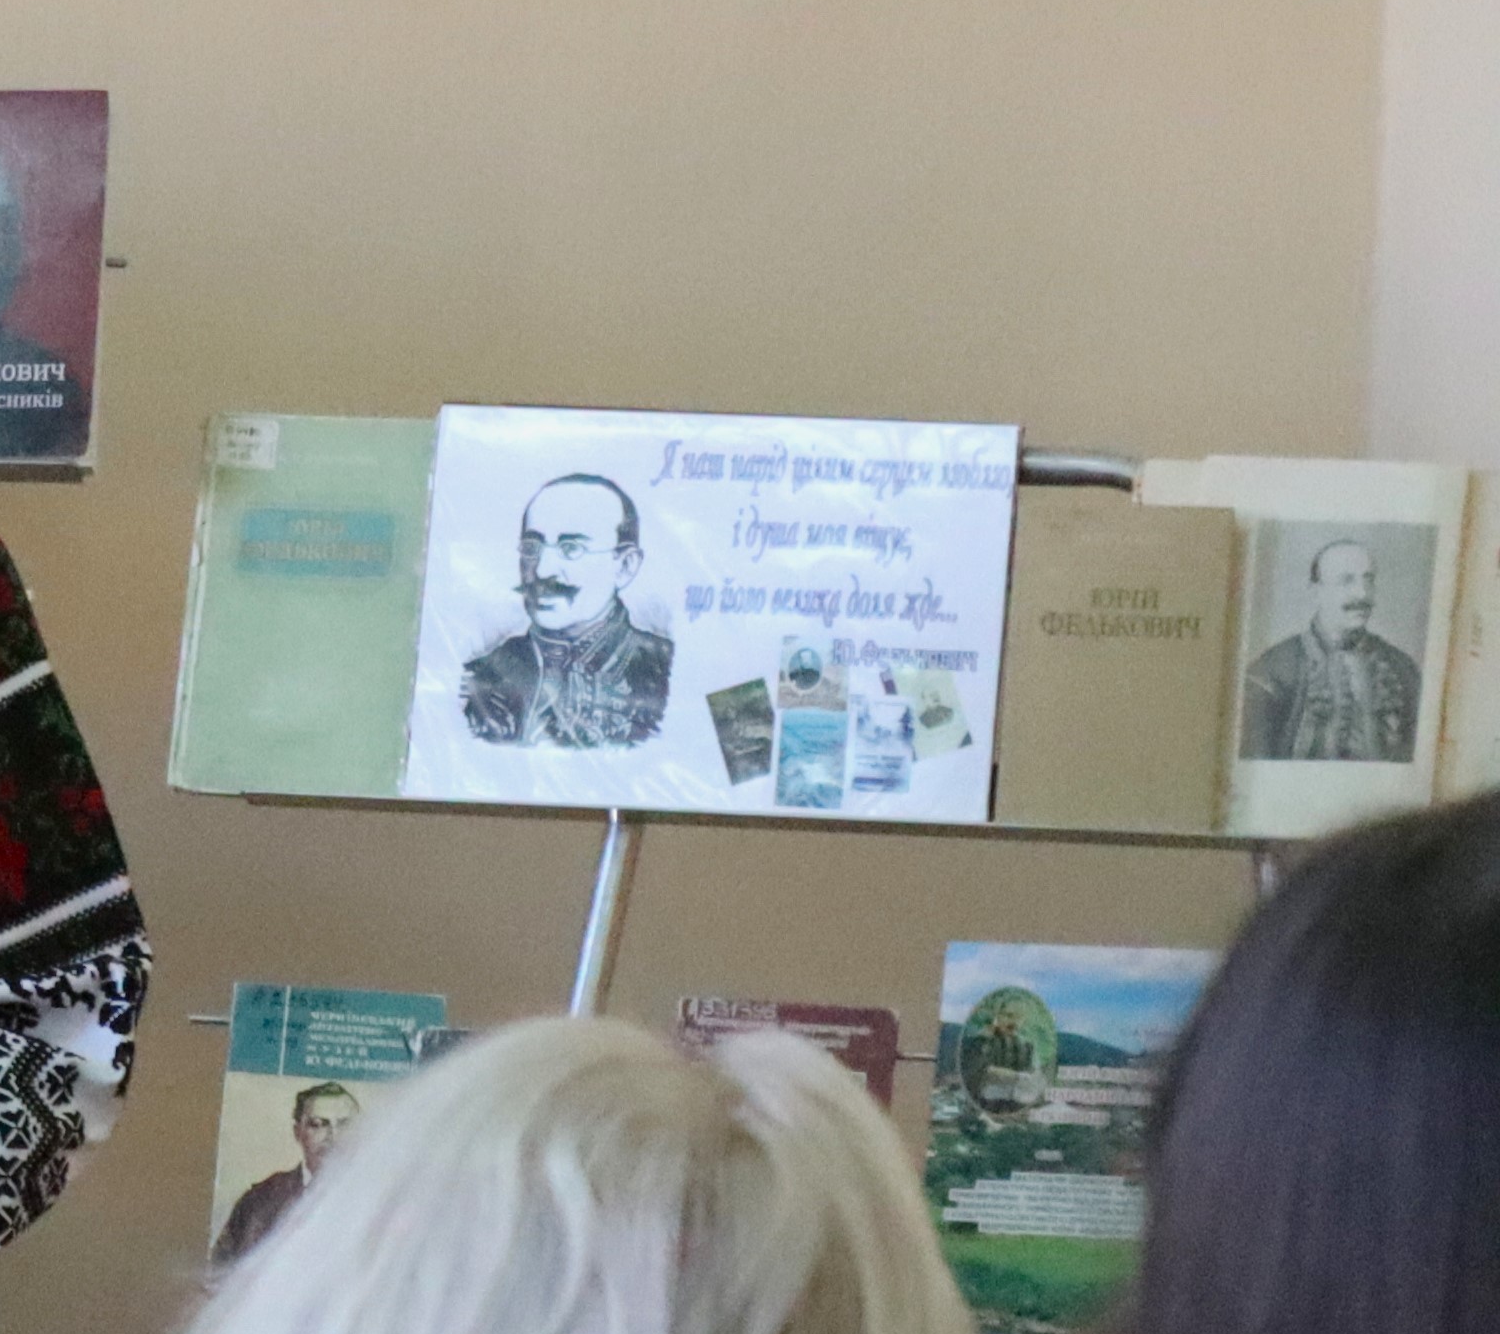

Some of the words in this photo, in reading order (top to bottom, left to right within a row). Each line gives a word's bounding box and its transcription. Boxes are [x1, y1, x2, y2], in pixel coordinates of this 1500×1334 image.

[745, 504, 800, 564] душа
[802, 523, 848, 550] моя
[1091, 587, 1161, 611] ЮРІЙ
[1041, 611, 1201, 639] ФЕДЬКОВИЧ
